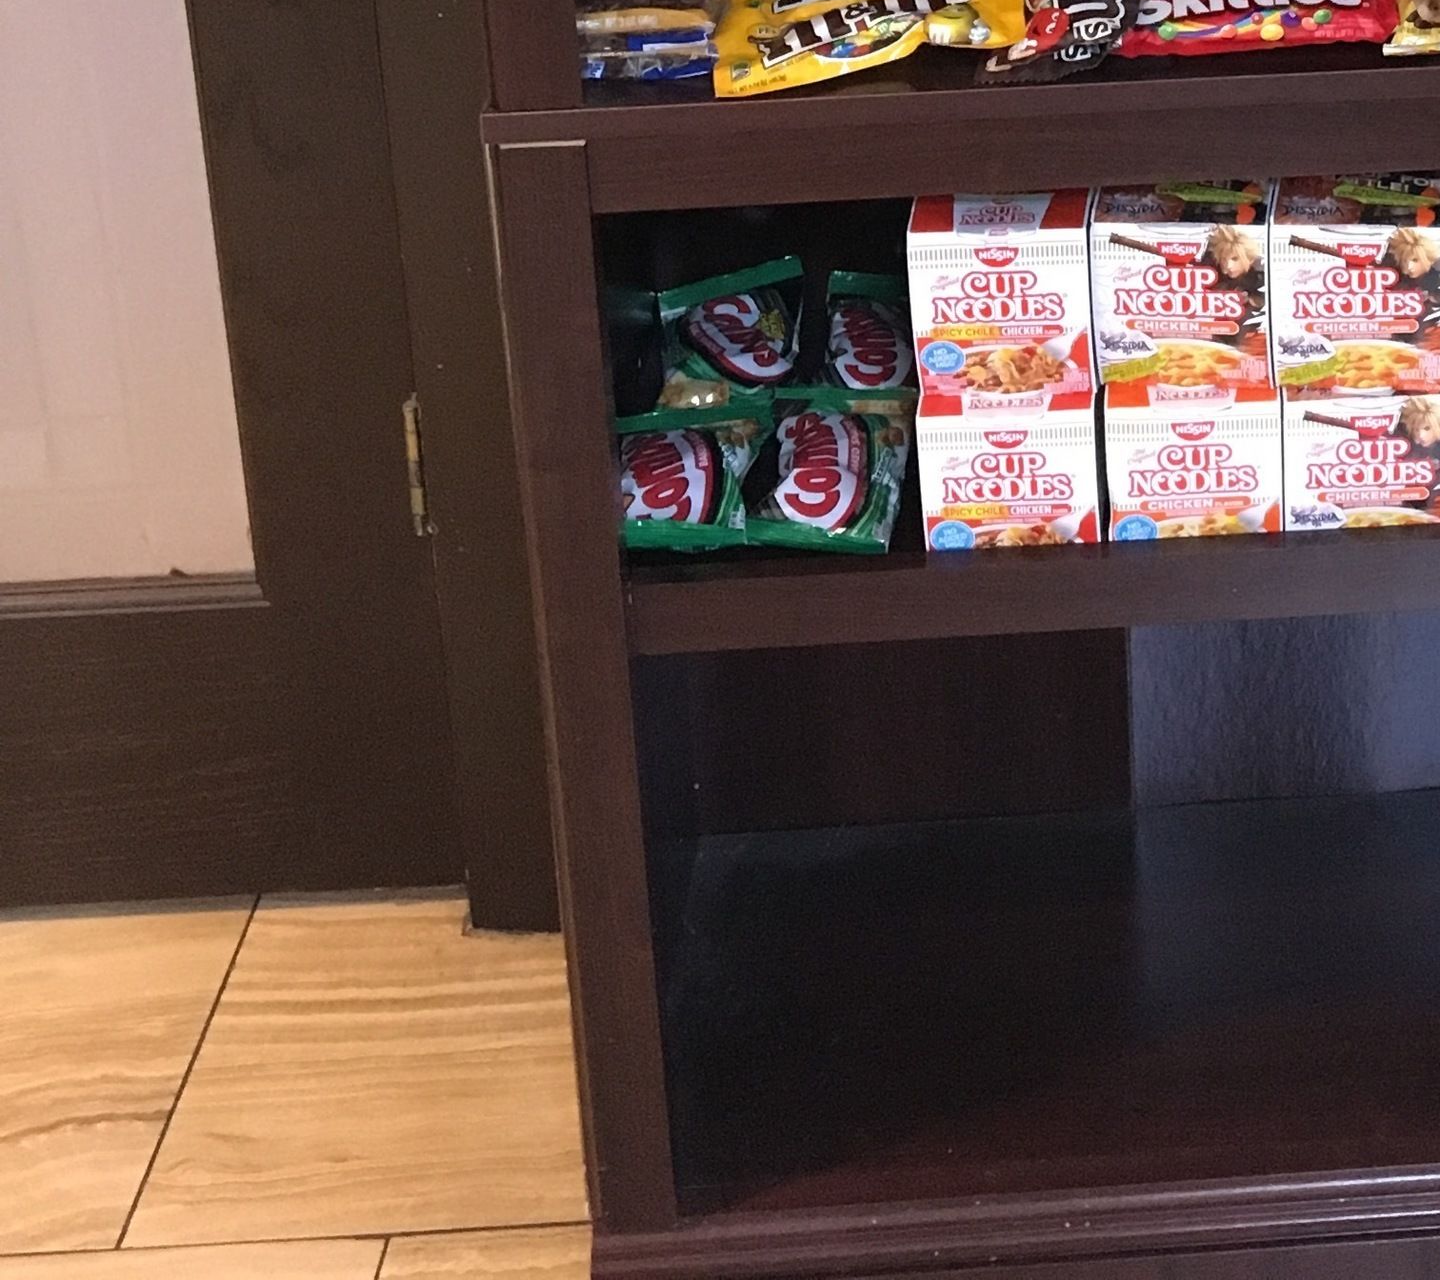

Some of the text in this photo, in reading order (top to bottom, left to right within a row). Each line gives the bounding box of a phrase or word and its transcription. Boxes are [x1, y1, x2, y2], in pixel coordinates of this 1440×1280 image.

[959, 213, 1035, 226] NOODLES
[978, 247, 1016, 262] NISSIN
[1160, 243, 1199, 256] NISSIN
[1341, 245, 1379, 258] NISSIN
[962, 271, 1037, 298] CUP
[1144, 265, 1219, 292] CUP
[1323, 267, 1399, 293] CUP
[932, 293, 1065, 324] NOODLES
[1114, 289, 1245, 318] NOODLES
[1293, 290, 1423, 320] NOODLES
[1001, 325, 1044, 336] CHICKEN
[1134, 320, 1200, 331] CHICKEN
[1312, 322, 1380, 333] CHICKEN
[1175, 423, 1211, 435] NISSIN
[1354, 417, 1389, 428] NISSIN
[988, 433, 1024, 443] NISSIN
[1157, 444, 1233, 470] CUP
[1336, 439, 1411, 464] CUP
[783, 413, 842, 518] Combos
[971, 452, 1046, 477] CUP
[1305, 459, 1435, 488] NOODLES
[942, 474, 1074, 503] NOODLES
[1128, 465, 1259, 497] NOODLES
[1147, 498, 1214, 510] CHICKEN
[1325, 491, 1391, 502] CHICKEN
[1010, 505, 1052, 515] CHICKEN
